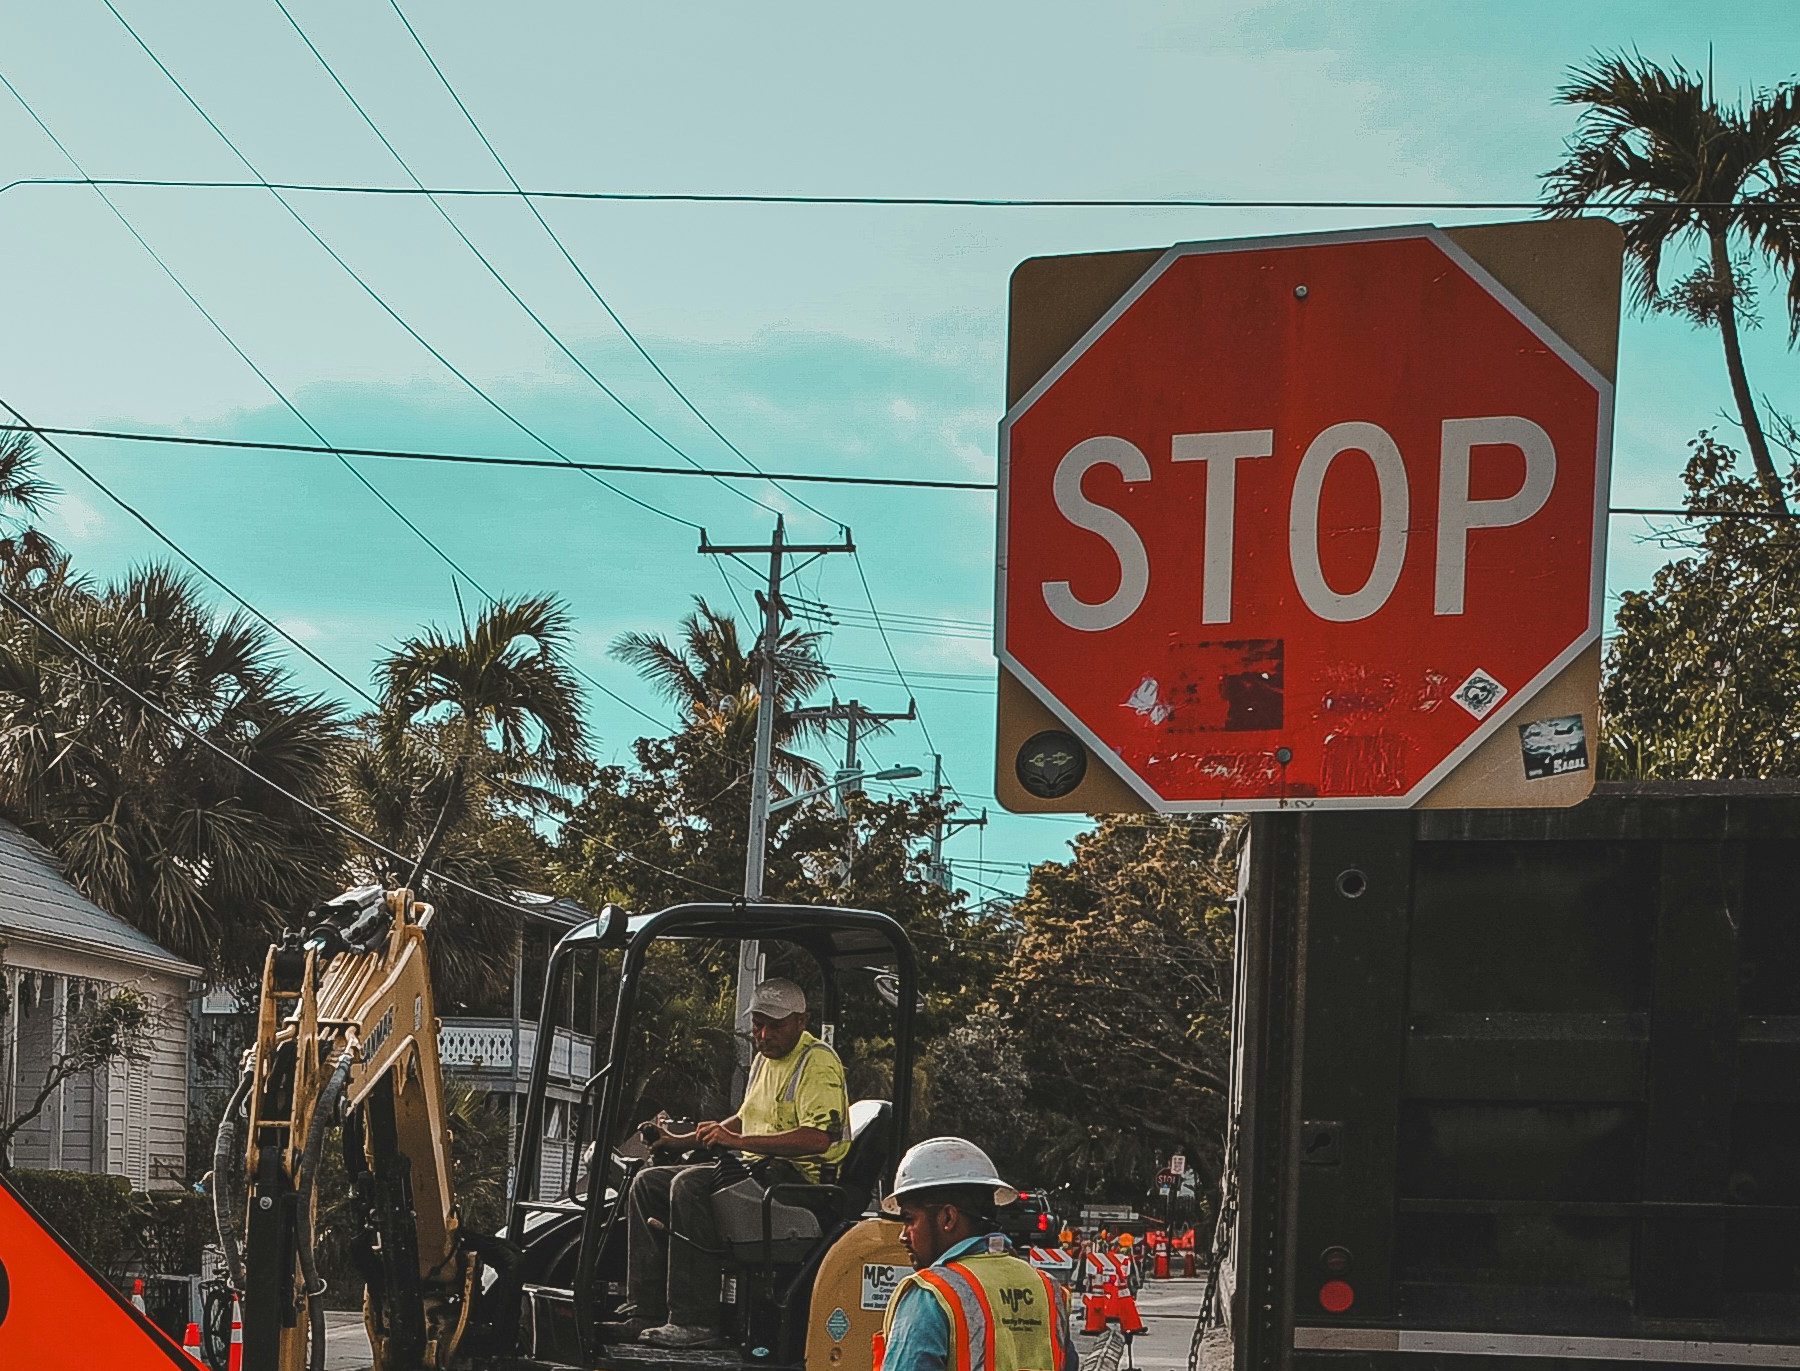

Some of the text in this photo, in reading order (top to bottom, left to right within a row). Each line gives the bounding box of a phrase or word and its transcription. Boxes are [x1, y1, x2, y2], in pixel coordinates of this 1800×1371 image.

[1041, 415, 1557, 632] STOP
[864, 1265, 895, 1288] MPC
[999, 1288, 1034, 1313] MPC
